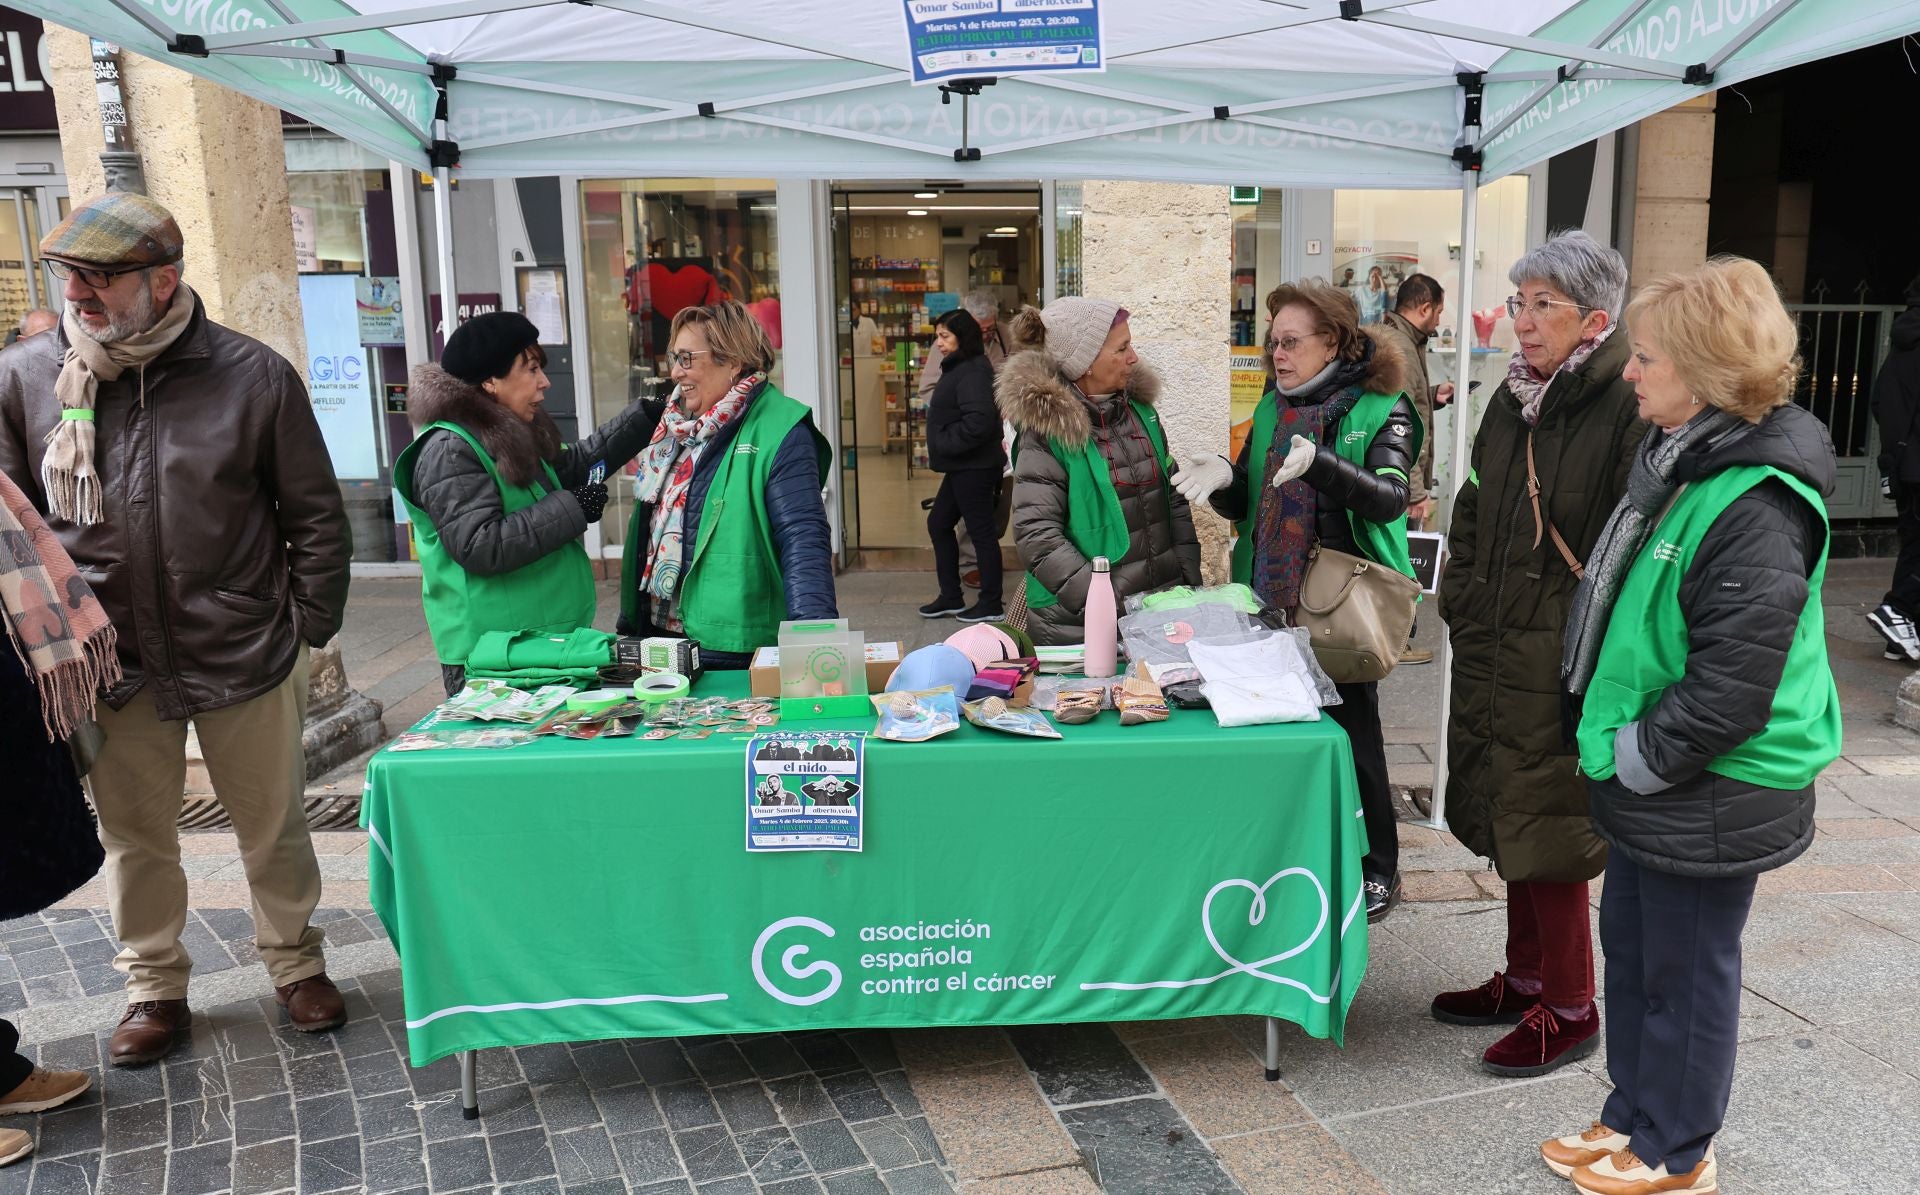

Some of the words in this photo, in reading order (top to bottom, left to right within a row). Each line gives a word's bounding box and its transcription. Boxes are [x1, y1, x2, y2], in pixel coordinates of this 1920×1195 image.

[916, 3, 947, 13] Omar
[953, 0, 993, 11] Samba
[926, 23, 957, 32] Martes
[960, 22, 966, 30] 4
[968, 21, 979, 29] de
[982, 18, 1016, 28] Febrero
[1047, 16, 1079, 25] 20:30h
[917, 34, 956, 47] TEATRO
[960, 30, 1016, 43] PRINCIPAL
[1021, 30, 1036, 39] DE
[1039, 26, 1094, 38] PALENCIA
[784, 762, 795, 772] el
[799, 762, 828, 773] nido
[860, 919, 991, 942] asociación
[860, 946, 972, 972] española
[861, 974, 940, 995] contra
[946, 971, 966, 990] el
[973, 972, 1056, 992] cáncer
